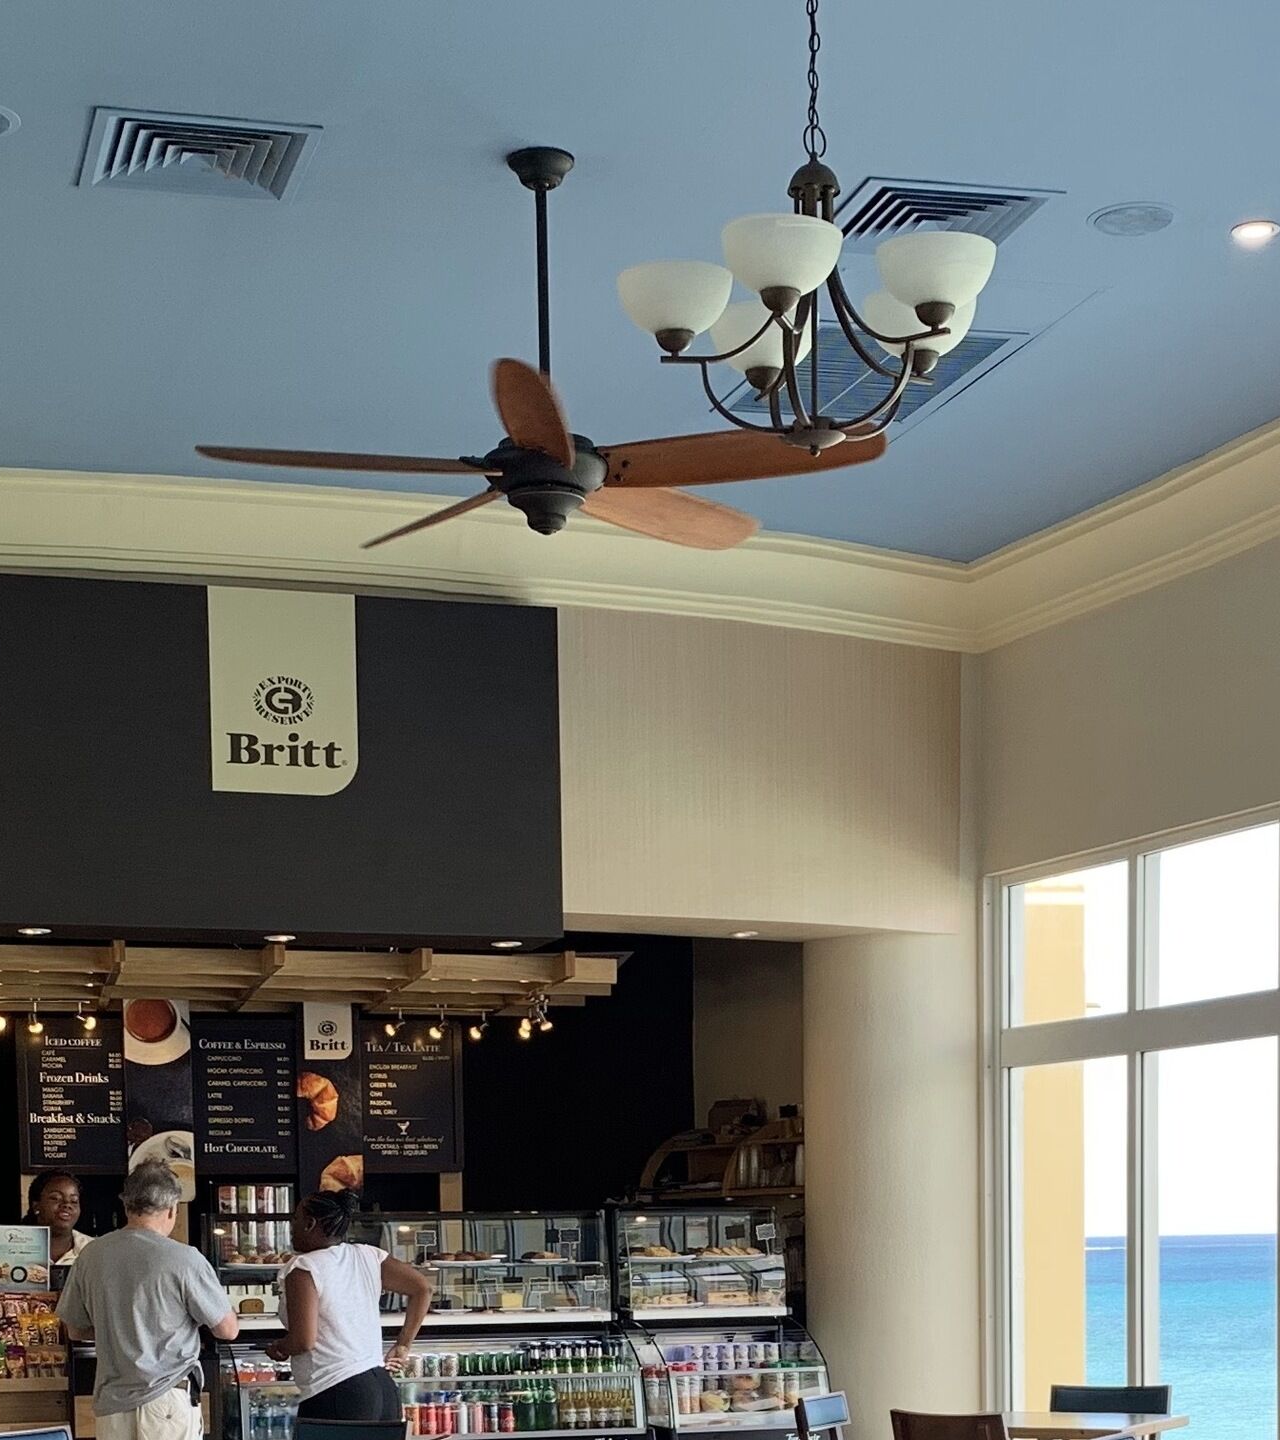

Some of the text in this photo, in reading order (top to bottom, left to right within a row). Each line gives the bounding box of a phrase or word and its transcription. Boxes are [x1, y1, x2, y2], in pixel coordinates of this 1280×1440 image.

[258, 676, 311, 693] EXPORT
[256, 705, 312, 725] RESERVE
[226, 732, 342, 769] Britt
[310, 1038, 346, 1051] Britt
[40, 1071, 109, 1083] Frozen Drinks
[30, 1112, 121, 1124] Breakfast & Snacks
[225, 1143, 278, 1153] CHOCOLATE
